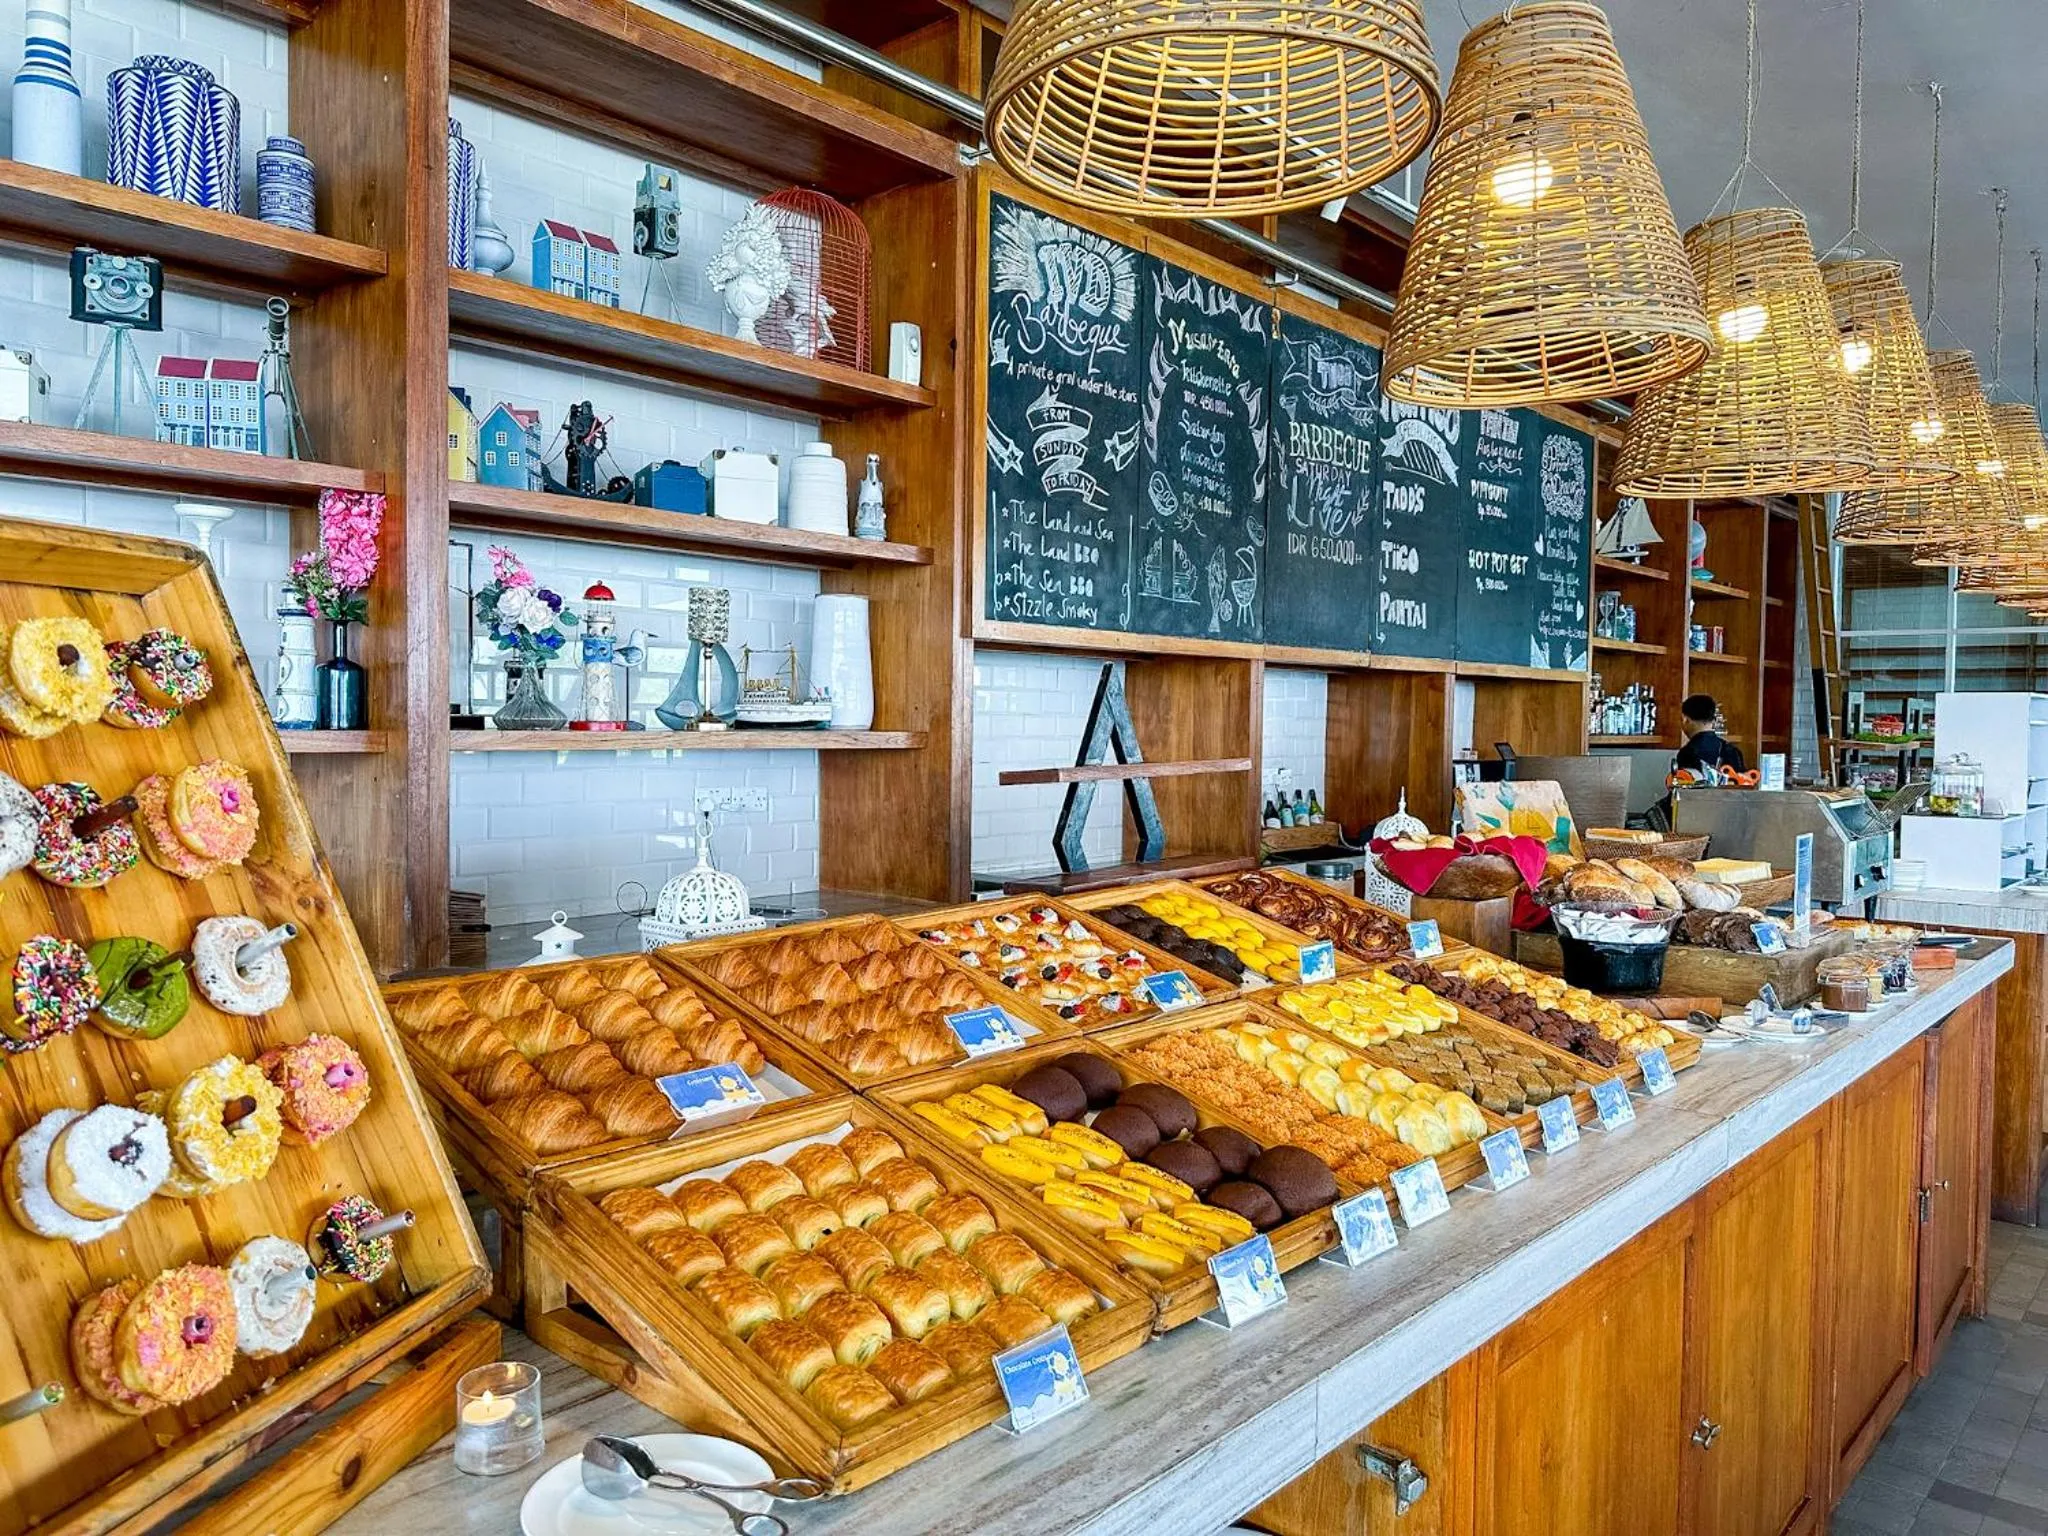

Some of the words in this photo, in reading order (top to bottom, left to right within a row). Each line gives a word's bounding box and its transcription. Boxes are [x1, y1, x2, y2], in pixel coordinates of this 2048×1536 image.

[1011, 293, 1130, 374] Barbeque
[1017, 361, 1054, 381] private
[1077, 373, 1103, 393] under
[1118, 387, 1138, 403] stars
[1042, 409, 1070, 421] FROM
[1040, 439, 1082, 458] SUNDAY
[1289, 421, 1371, 474] BARBECUE
[1045, 477, 1058, 489] TO
[1059, 471, 1093, 490] FRIDAY
[1295, 457, 1352, 487] SATURDAY
[1009, 499, 1037, 524] The
[1043, 501, 1070, 533] Land
[1073, 520, 1092, 536] and
[1095, 518, 1114, 542] Sea
[1287, 475, 1352, 538] Live
[1009, 530, 1035, 556] The
[1041, 535, 1070, 562] Land
[1074, 543, 1100, 566] BBQ
[1288, 532, 1307, 556] IDR
[1011, 559, 1034, 589] The
[1039, 569, 1066, 596] Sea
[1070, 575, 1093, 597] BBQ
[1491, 551, 1509, 575] POT
[1010, 592, 1053, 617] Sizzle
[1057, 597, 1098, 626] Smoky
[1380, 591, 1427, 630] PANTAI
